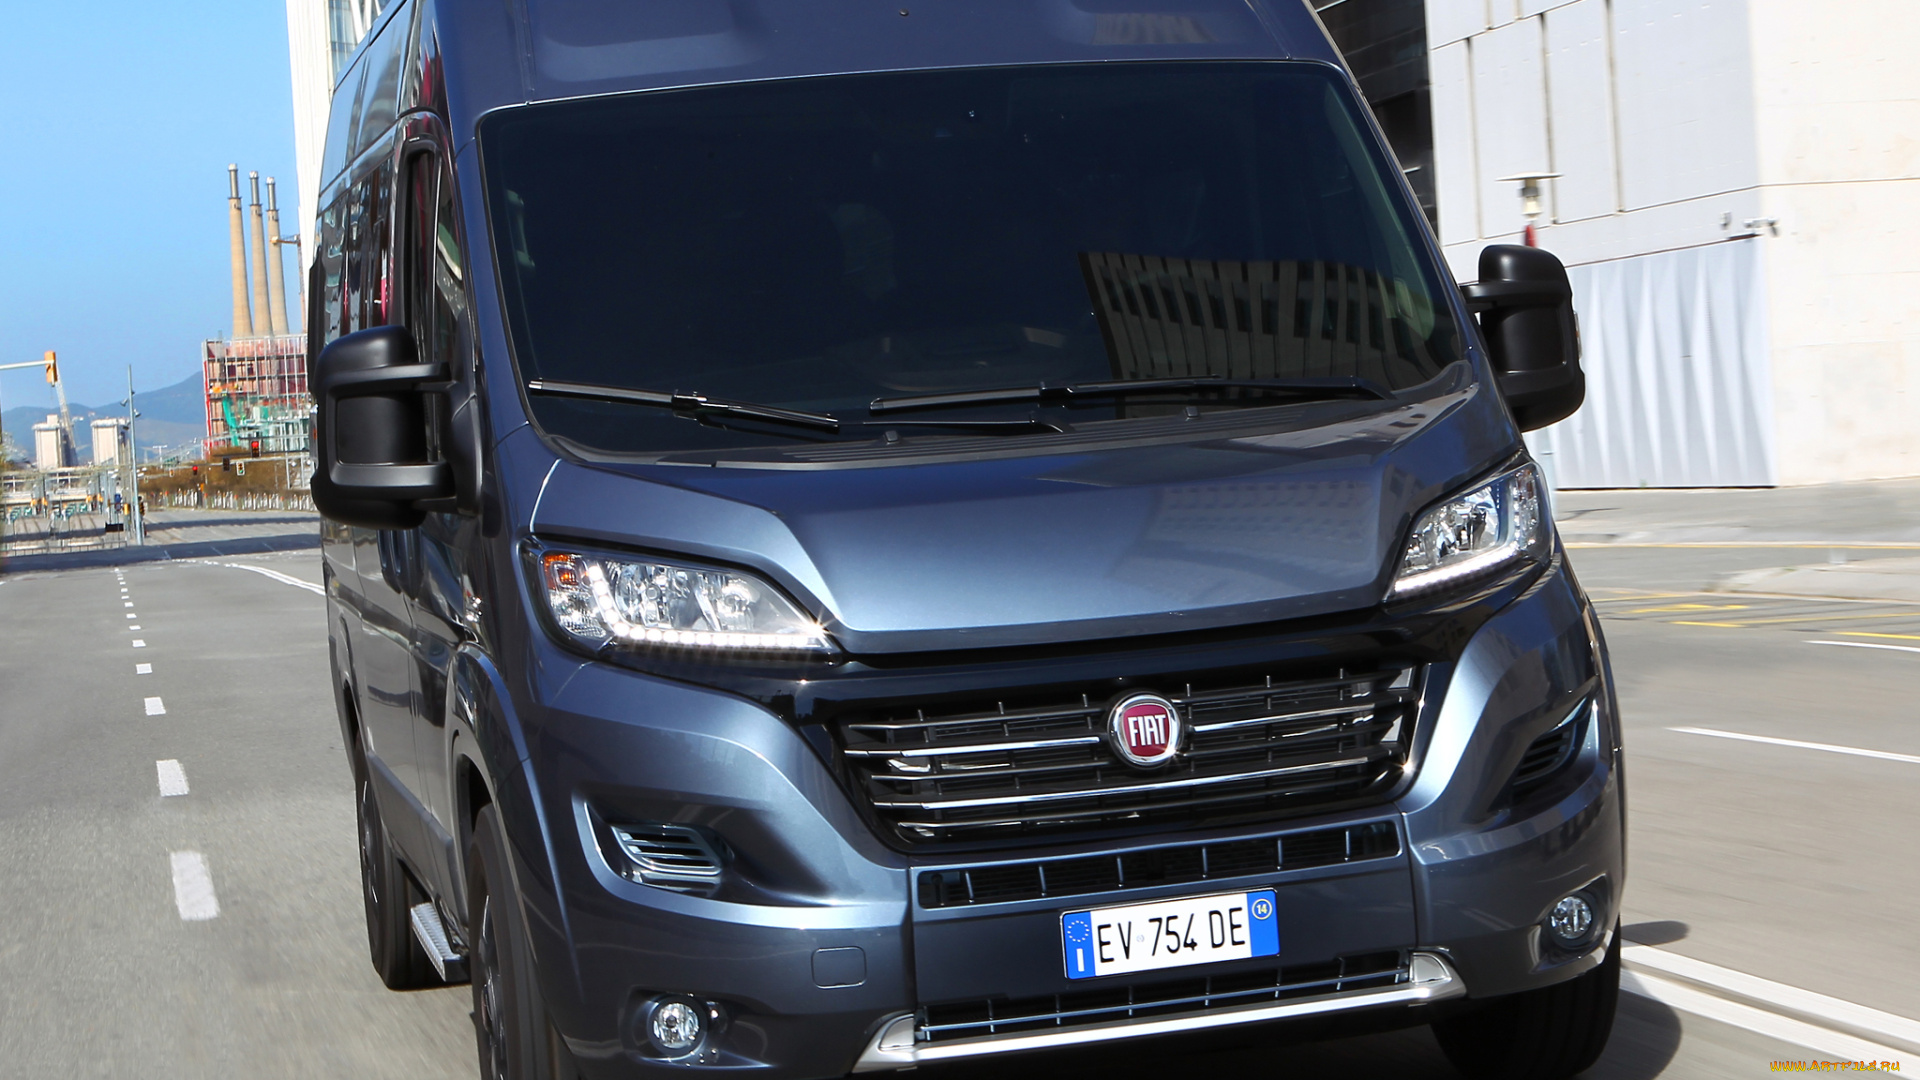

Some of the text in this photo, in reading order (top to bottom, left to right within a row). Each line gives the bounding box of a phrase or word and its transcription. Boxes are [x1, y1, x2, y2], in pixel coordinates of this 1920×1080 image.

[1128, 714, 1166, 747] FIAT
[1256, 902, 1267, 914] 14
[1098, 907, 1246, 963] EV 754 DE
